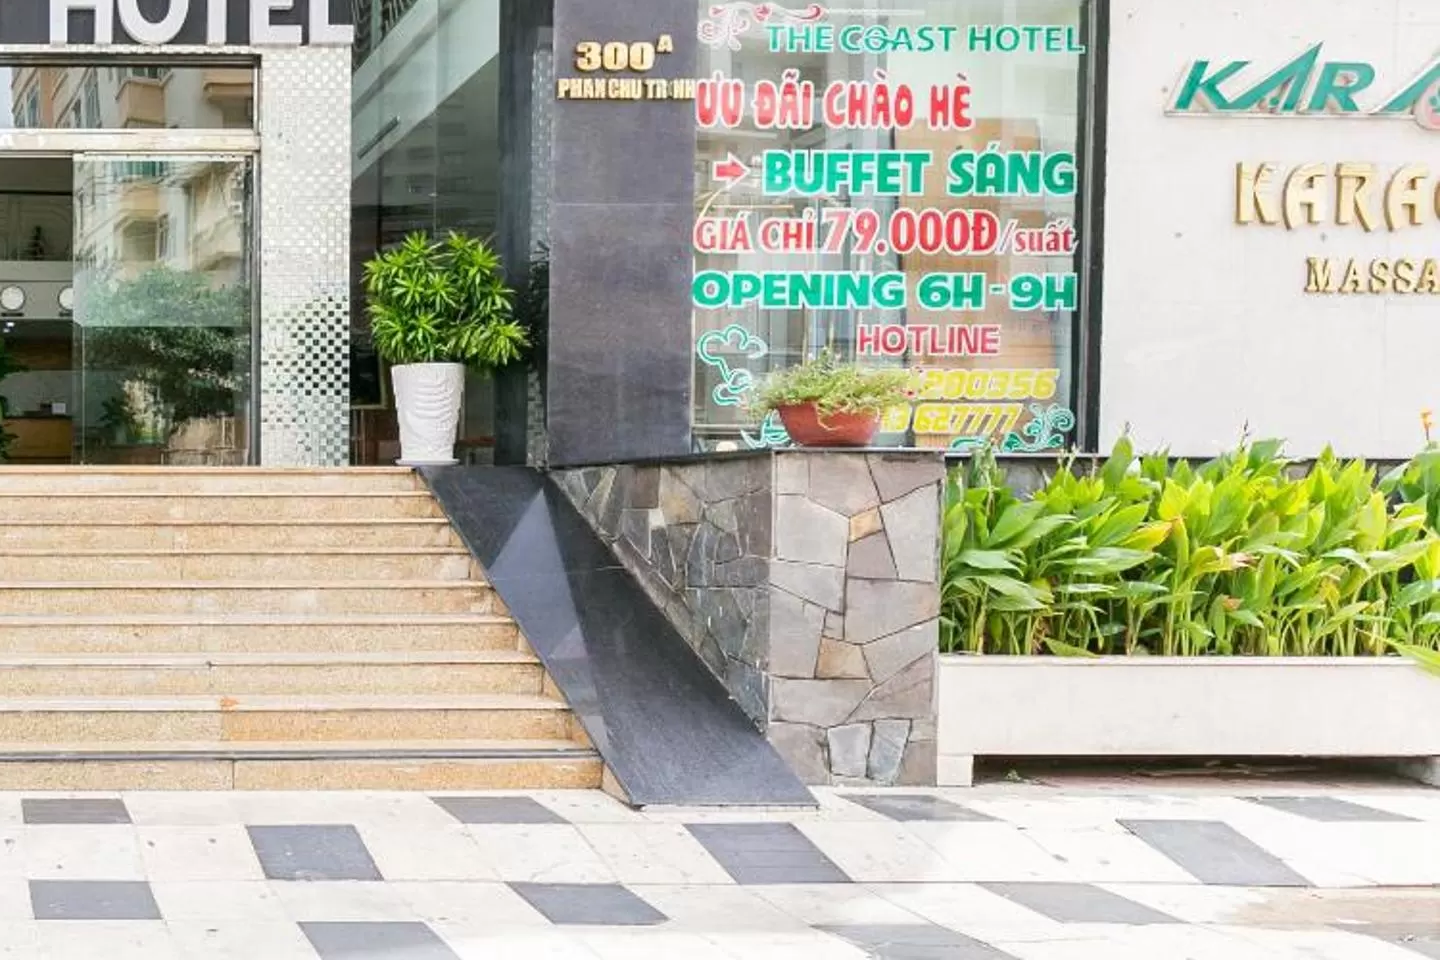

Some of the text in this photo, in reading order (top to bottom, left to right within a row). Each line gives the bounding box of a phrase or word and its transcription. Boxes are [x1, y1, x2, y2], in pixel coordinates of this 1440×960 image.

[766, 24, 1086, 55] THE COAST HOTEL
[557, 78, 606, 100] PHAN
[607, 78, 643, 100] CHU
[751, 68, 814, 128] ĐÃI
[823, 70, 915, 129] CHÀO
[928, 72, 975, 130] HÈ
[762, 141, 1078, 197] BUFFET SÁNG
[1234, 161, 1440, 232] KARA
[694, 209, 755, 255] GIÁ
[758, 208, 816, 255] CHỈ
[691, 271, 907, 309] OPENING
[856, 324, 1003, 357] HOTLINE
